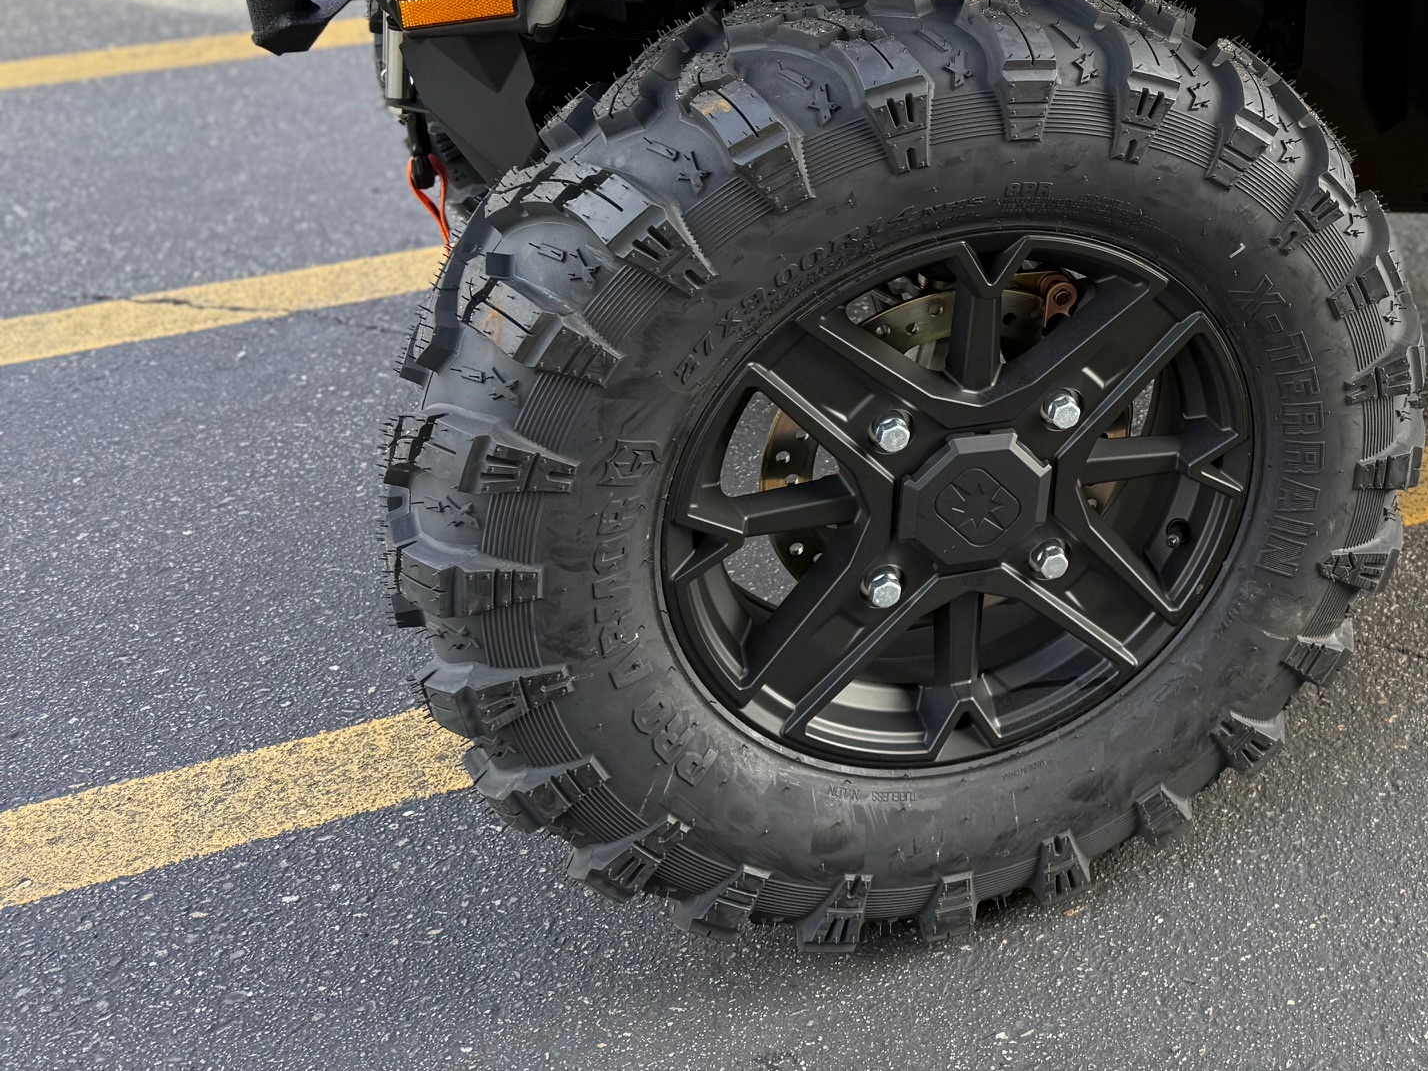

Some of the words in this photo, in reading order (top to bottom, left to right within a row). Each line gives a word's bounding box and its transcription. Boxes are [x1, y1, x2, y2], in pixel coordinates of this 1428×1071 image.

[1229, 273, 1326, 577] X-TERRAIN
[592, 494, 654, 689] ARMOR
[631, 689, 719, 787] PRO
[827, 785, 860, 802] NYLON
[871, 790, 918, 802] TUBELESS
